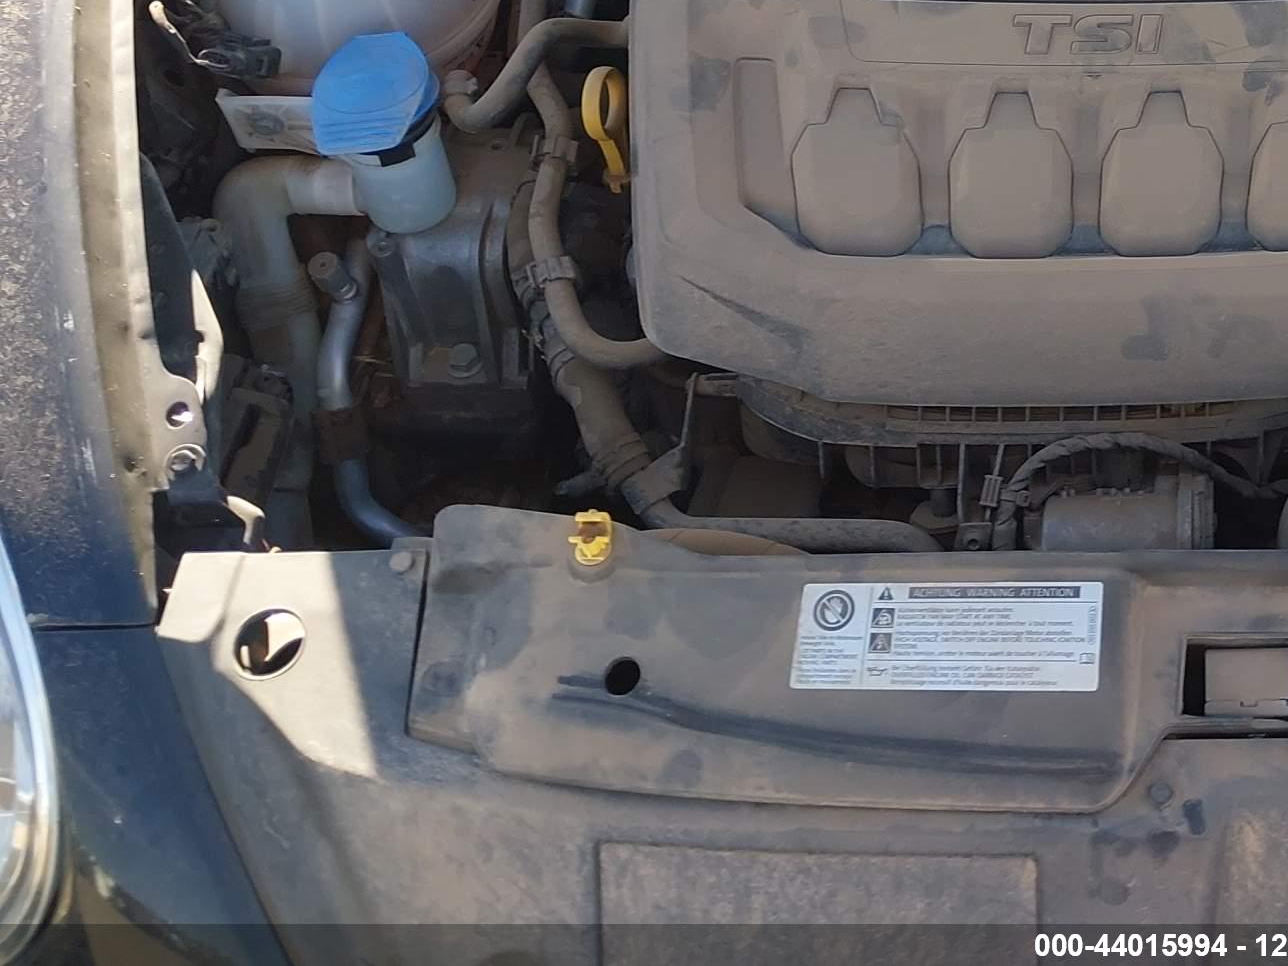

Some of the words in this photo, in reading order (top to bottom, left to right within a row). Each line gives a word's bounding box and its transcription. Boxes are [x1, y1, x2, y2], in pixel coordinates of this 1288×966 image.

[1013, 13, 1165, 56] TSI
[912, 587, 961, 598] ACHTUNG
[966, 587, 1016, 597] WARNING
[1019, 586, 1075, 597] ATTENTION
